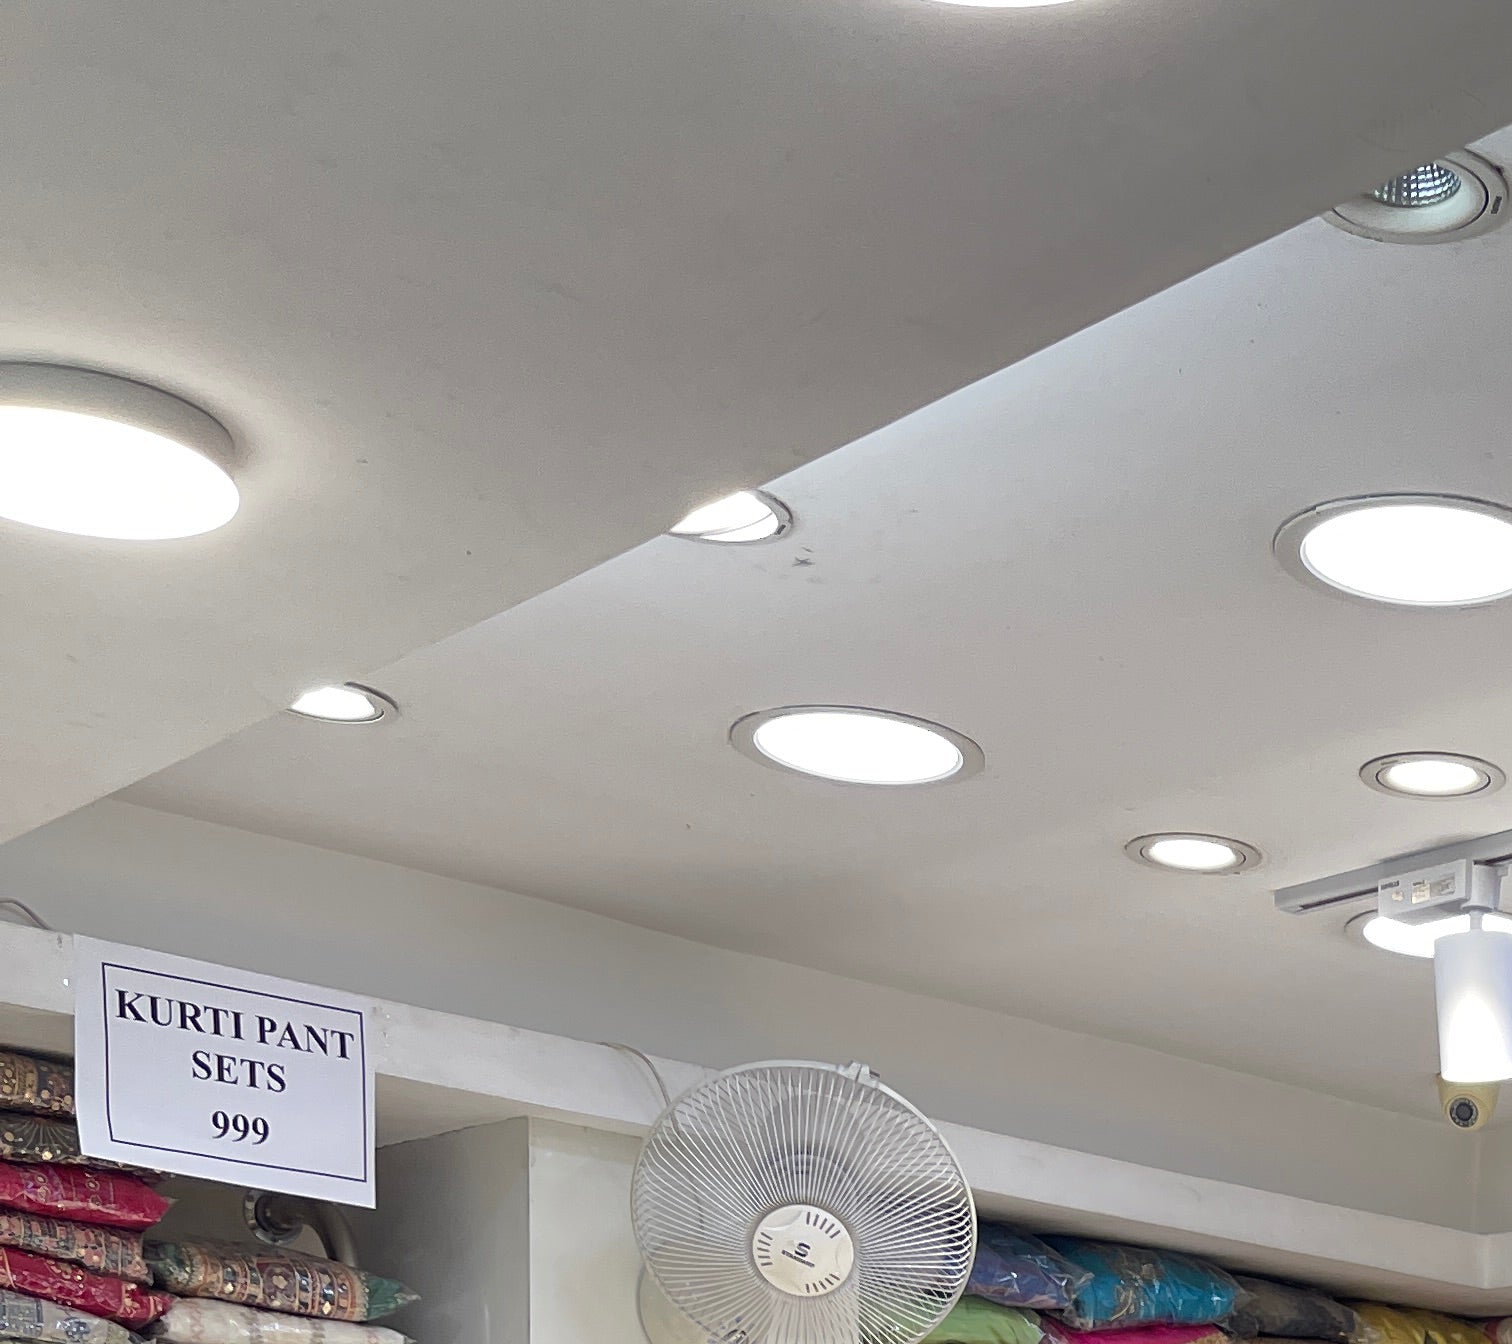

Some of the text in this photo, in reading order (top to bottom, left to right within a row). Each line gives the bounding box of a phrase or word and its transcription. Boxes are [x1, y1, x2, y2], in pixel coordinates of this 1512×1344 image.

[114, 988, 355, 1060] KURTI PANT
[191, 1049, 287, 1093] SETS
[211, 1110, 270, 1145] 999
